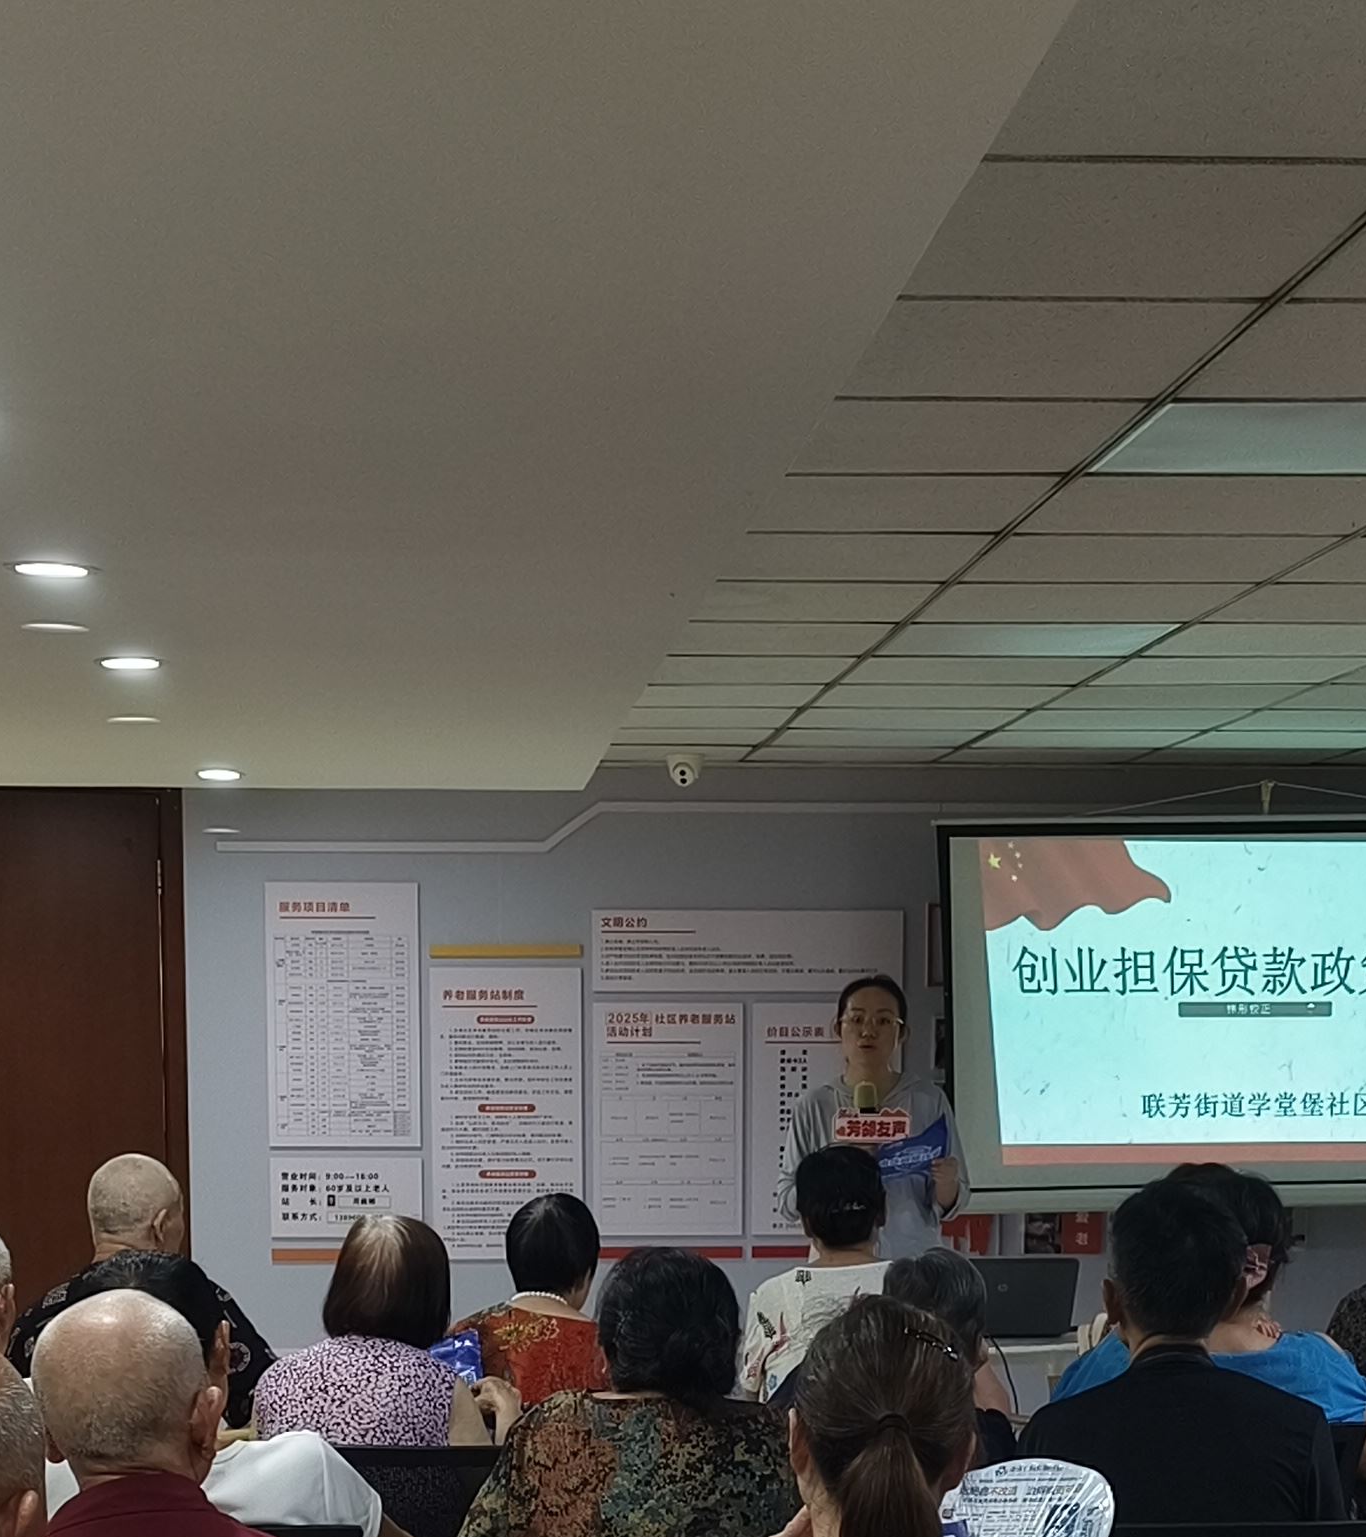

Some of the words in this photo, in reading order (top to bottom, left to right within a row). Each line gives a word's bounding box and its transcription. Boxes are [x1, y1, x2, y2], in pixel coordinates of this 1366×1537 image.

[279, 902, 351, 913] 服务项目清单
[601, 917, 648, 928] 文明公约
[442, 989, 525, 1001] 养老服务站制度
[608, 1012, 650, 1024] 2025年
[655, 1013, 736, 1025] 社区养老服务站
[606, 1026, 653, 1038] 活动计划
